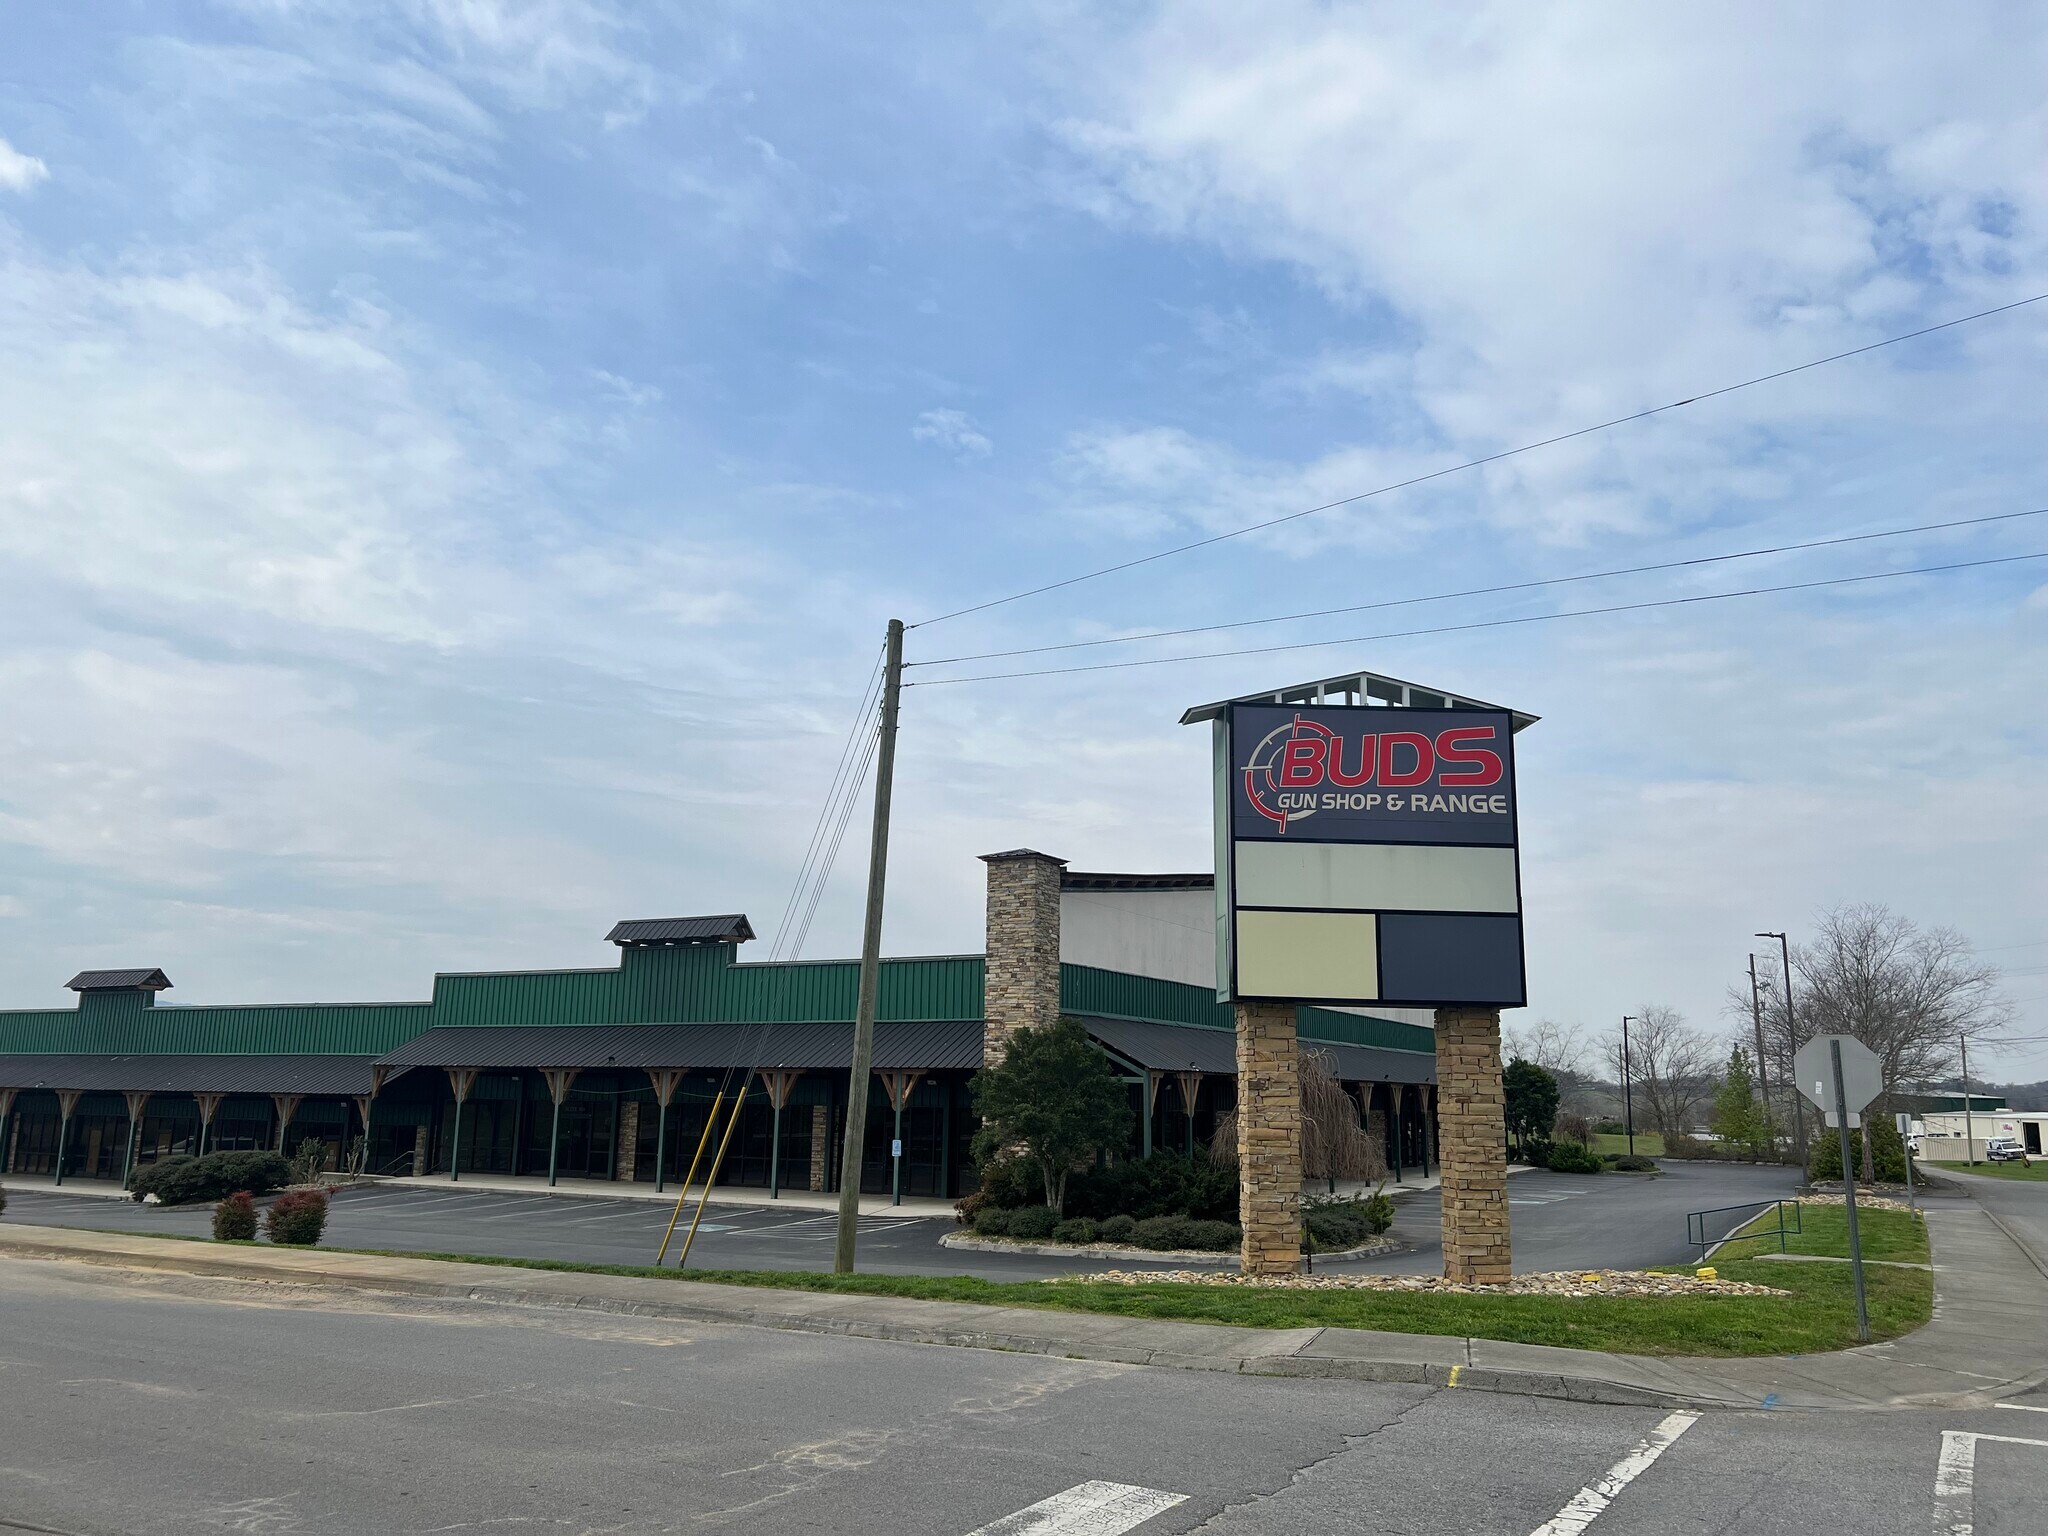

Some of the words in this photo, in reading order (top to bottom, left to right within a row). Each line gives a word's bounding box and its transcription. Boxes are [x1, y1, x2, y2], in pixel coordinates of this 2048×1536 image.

[1280, 726, 1503, 787] BUDS
[1277, 793, 1317, 809] GUN
[1321, 793, 1381, 811] SHOP
[1386, 794, 1405, 811] &
[1411, 794, 1507, 814] RANGE
